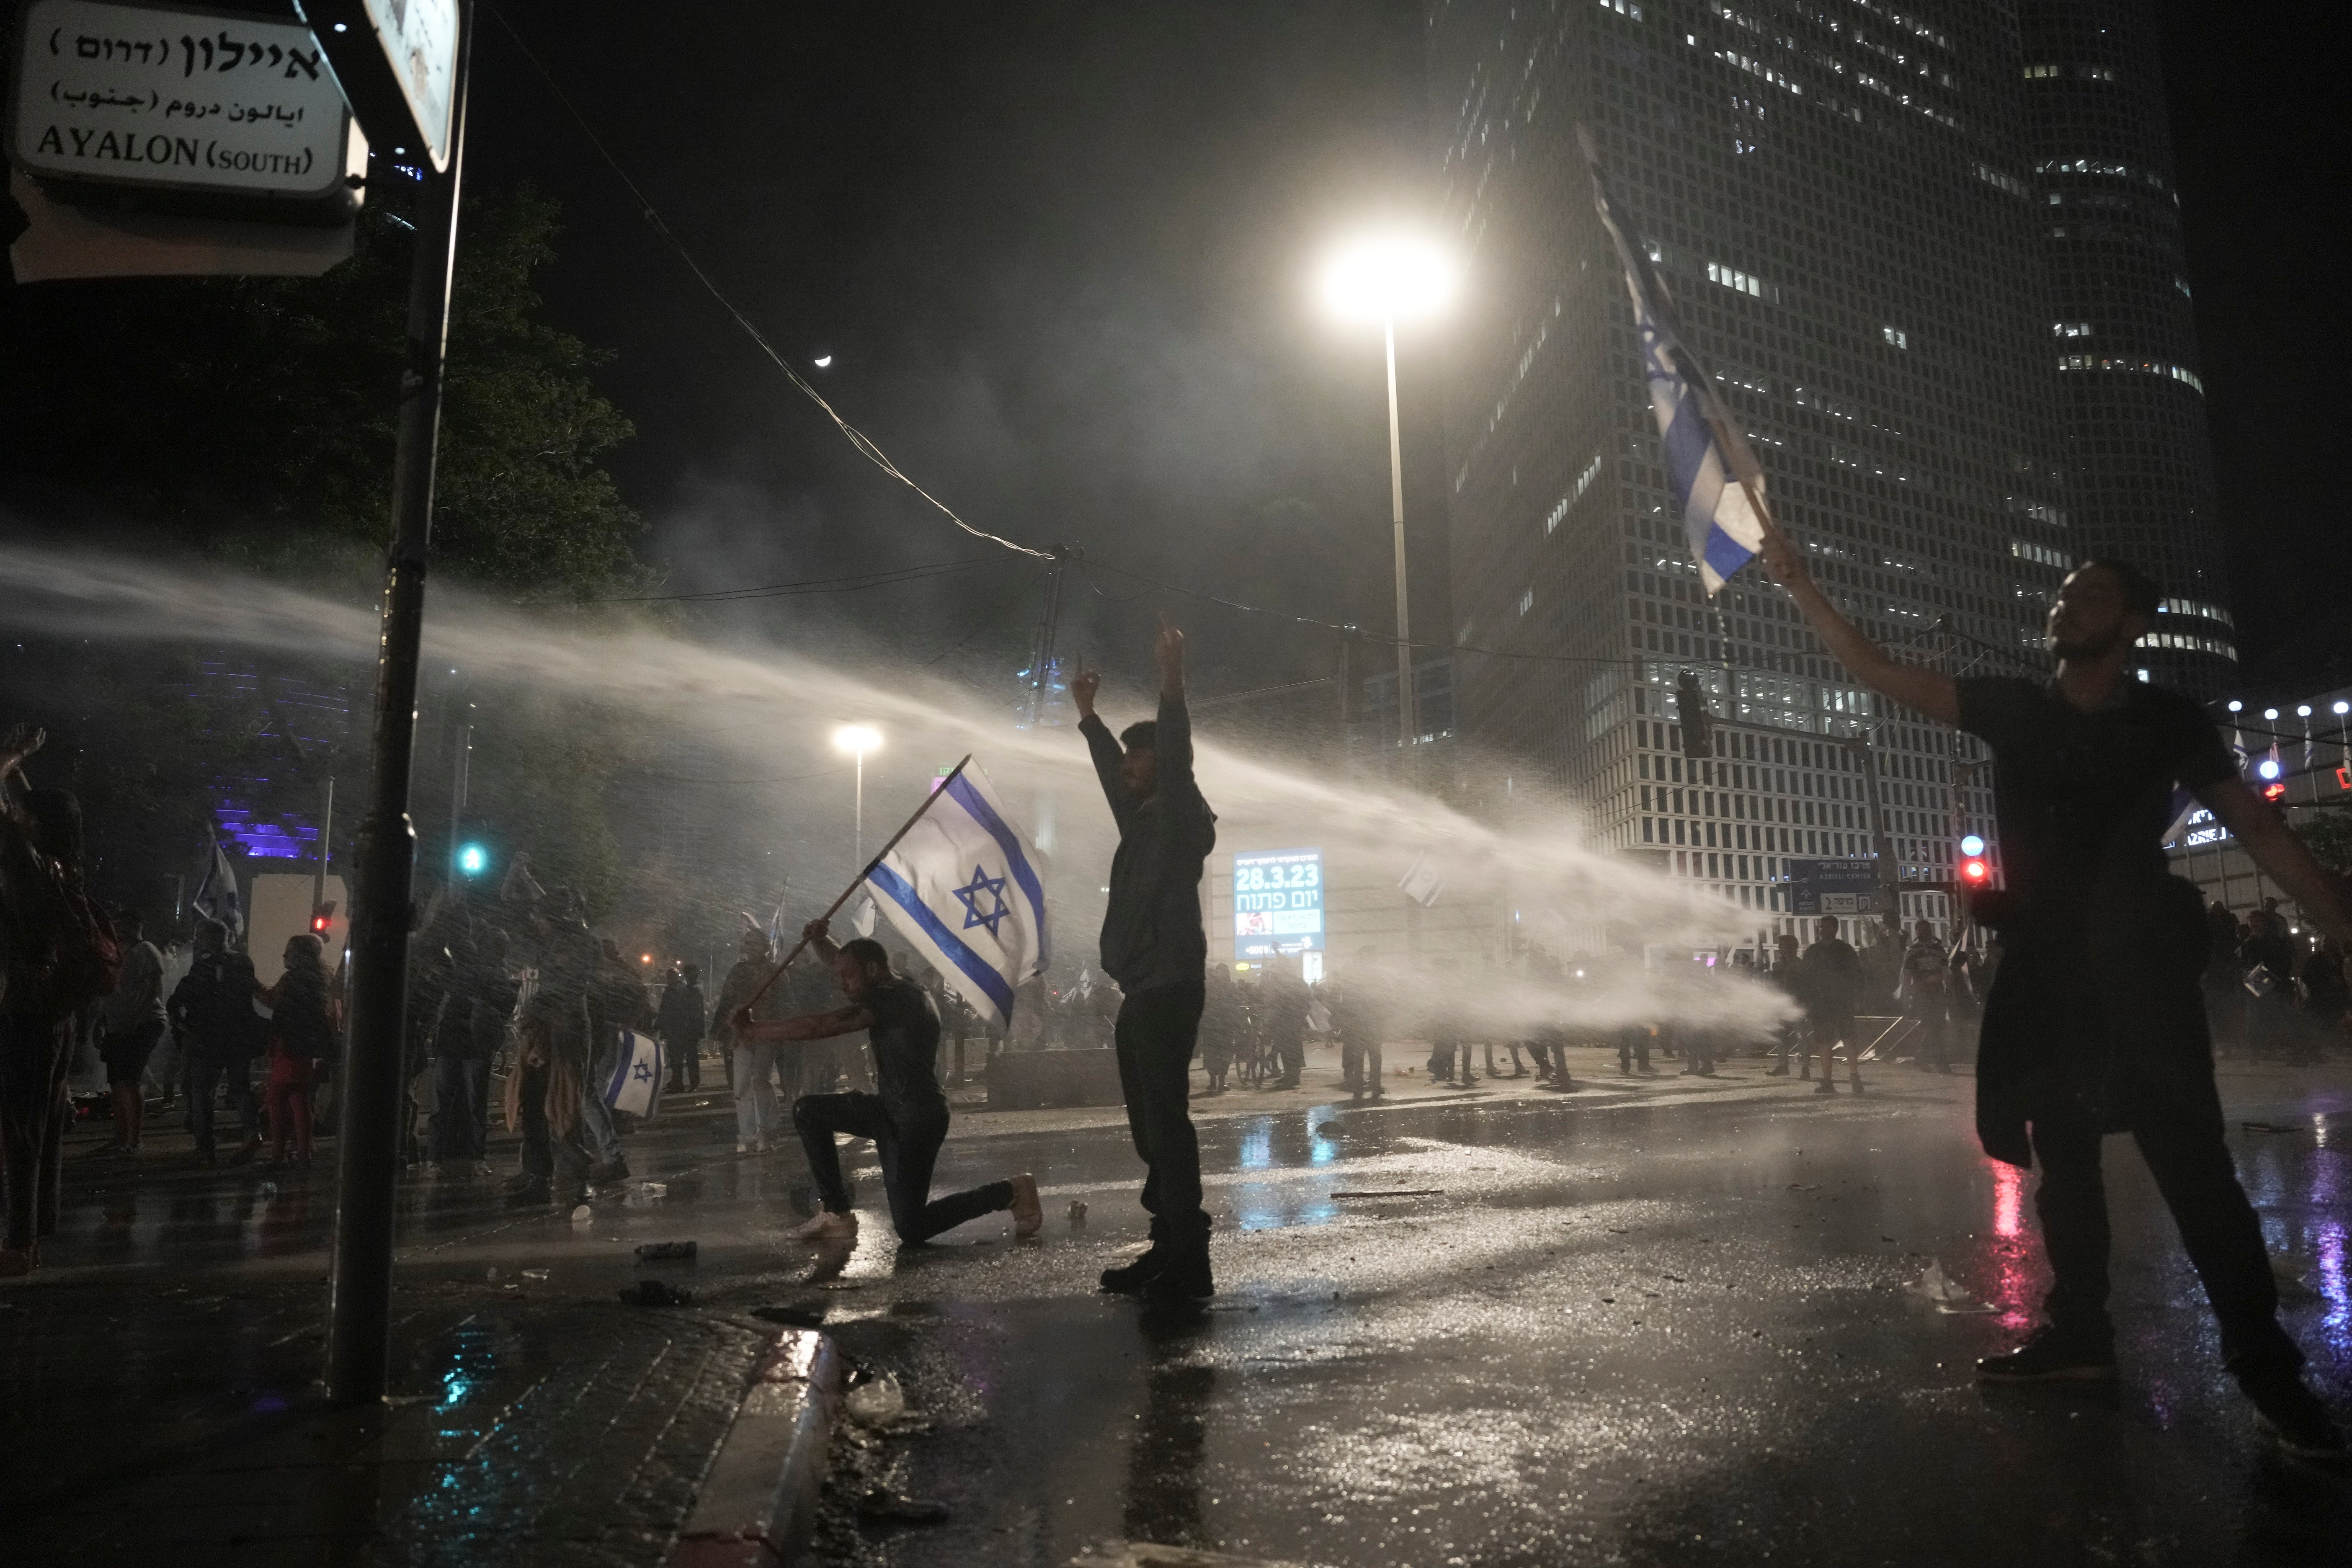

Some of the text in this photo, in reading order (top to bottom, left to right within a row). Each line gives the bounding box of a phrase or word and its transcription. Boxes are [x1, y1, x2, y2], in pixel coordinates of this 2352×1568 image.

[180, 31, 320, 81] איילון
[165, 98, 222, 119] دروم
[1236, 864, 1319, 891] 28.3.23
[1237, 890, 1318, 911] יום פתוח
[1825, 897, 1832, 910] 2
[1287, 923, 1307, 931] בחינוך
